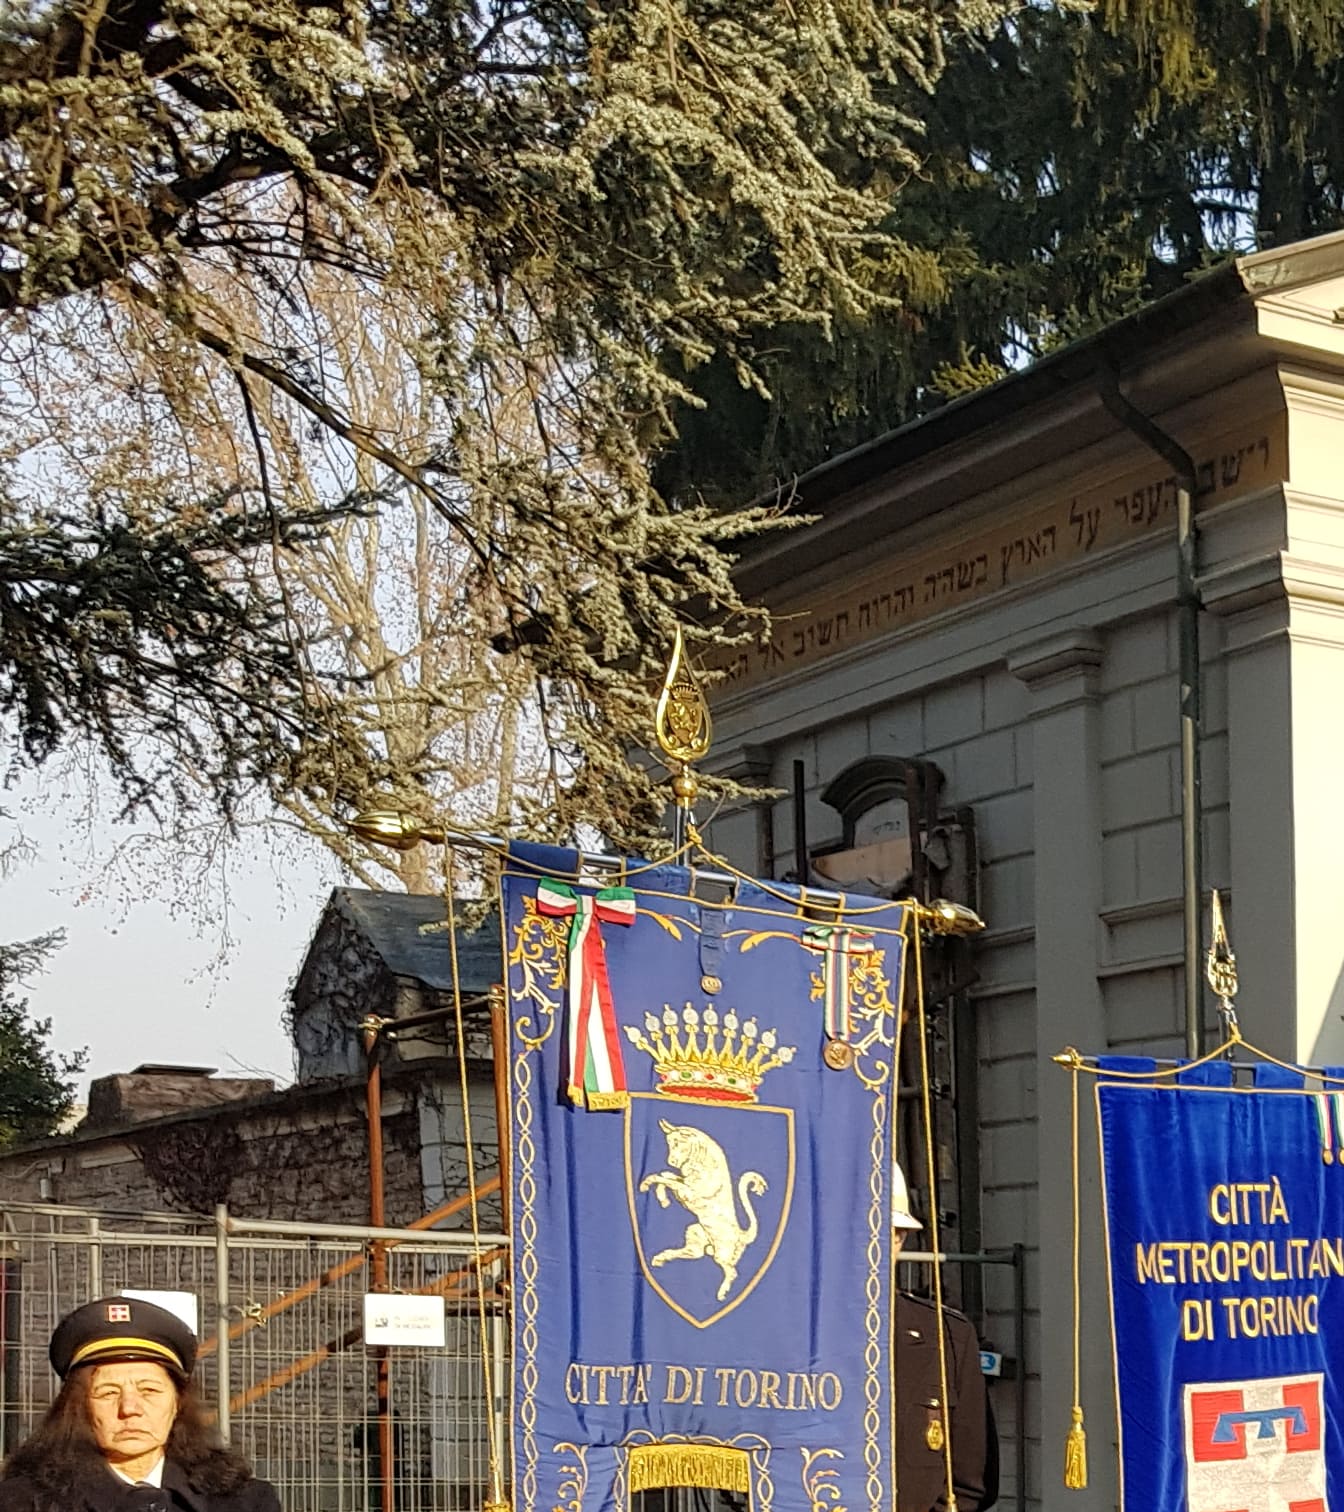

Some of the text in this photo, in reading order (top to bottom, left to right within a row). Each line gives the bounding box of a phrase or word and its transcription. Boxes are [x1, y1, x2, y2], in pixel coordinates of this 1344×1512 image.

[1069, 498, 1100, 550] על
[1001, 524, 1056, 586] הארץ
[1210, 1175, 1290, 1225] CITTÀ
[1183, 1295, 1319, 1341] DI TORINO
[565, 1363, 843, 1411] CITTA' DI TORINO
